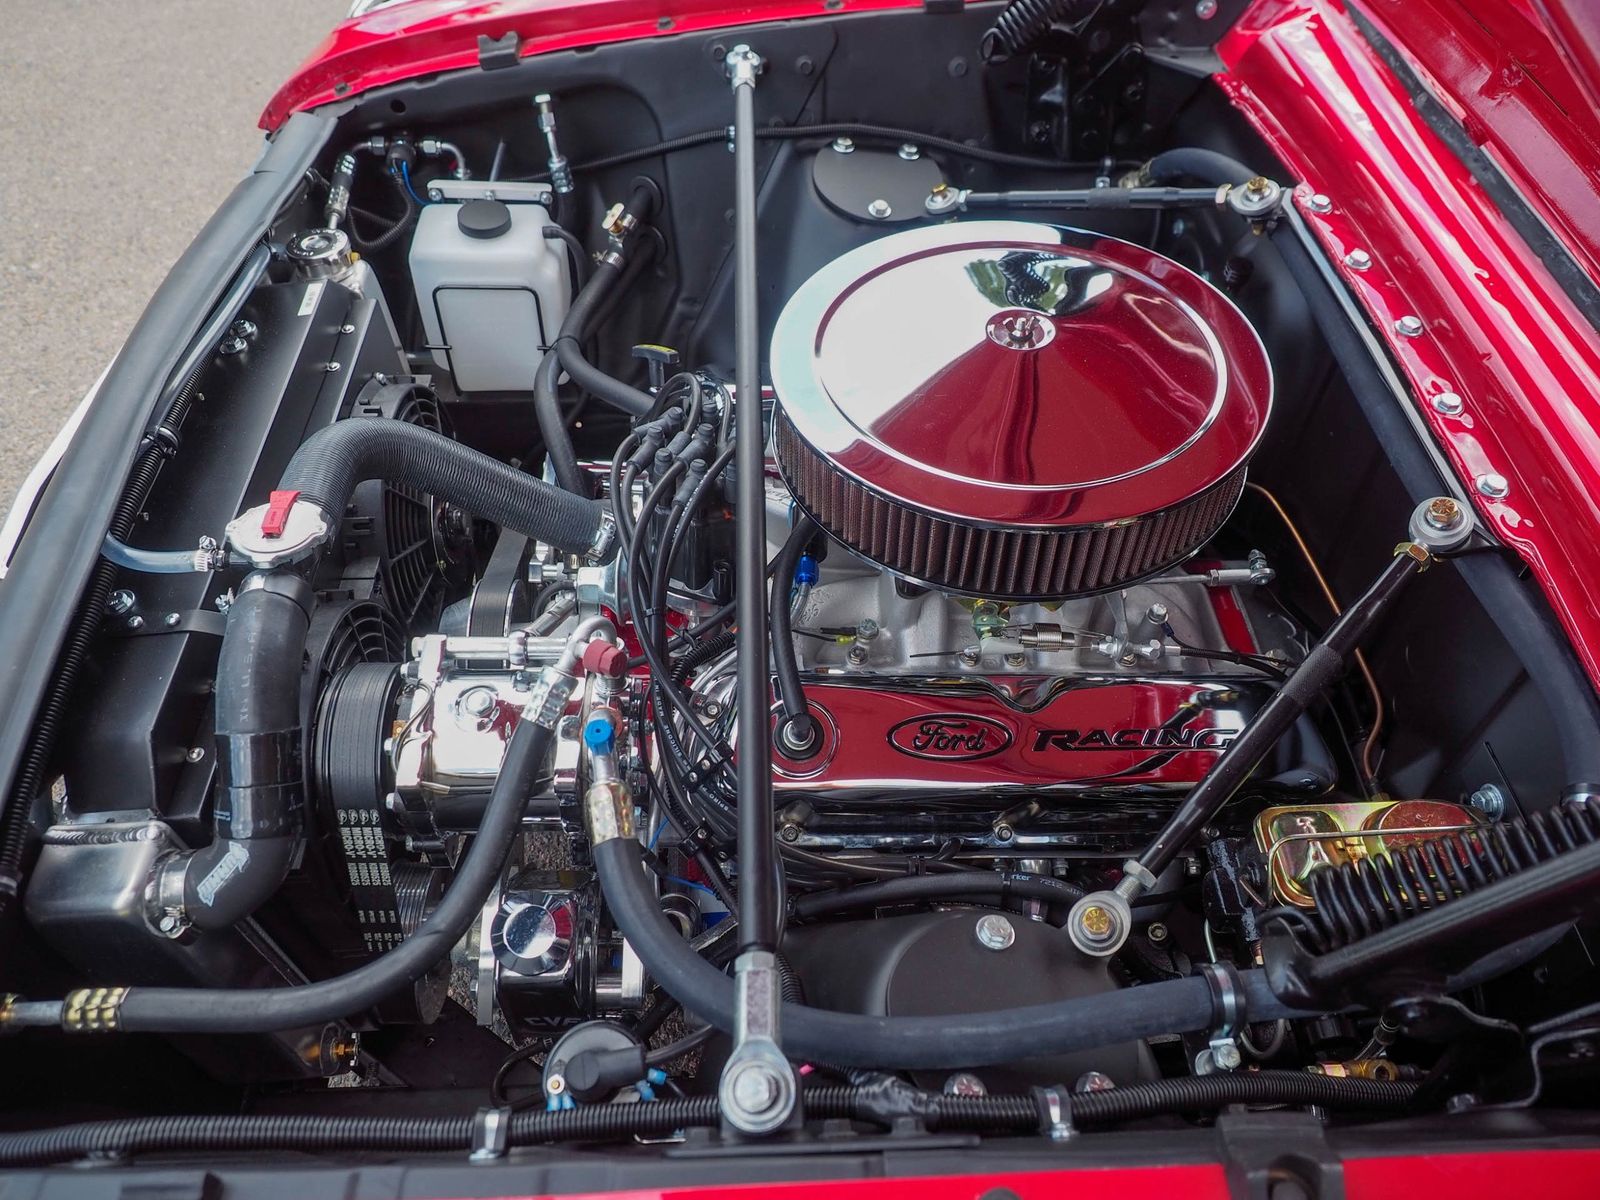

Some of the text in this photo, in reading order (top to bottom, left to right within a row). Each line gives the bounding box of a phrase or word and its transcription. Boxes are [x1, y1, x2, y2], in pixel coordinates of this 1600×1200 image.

[657, 696, 665, 718] MADE
[663, 724, 683, 758] SILICONE
[912, 720, 1240, 752] Ford RACING
[524, 1016, 582, 1026] CVF
